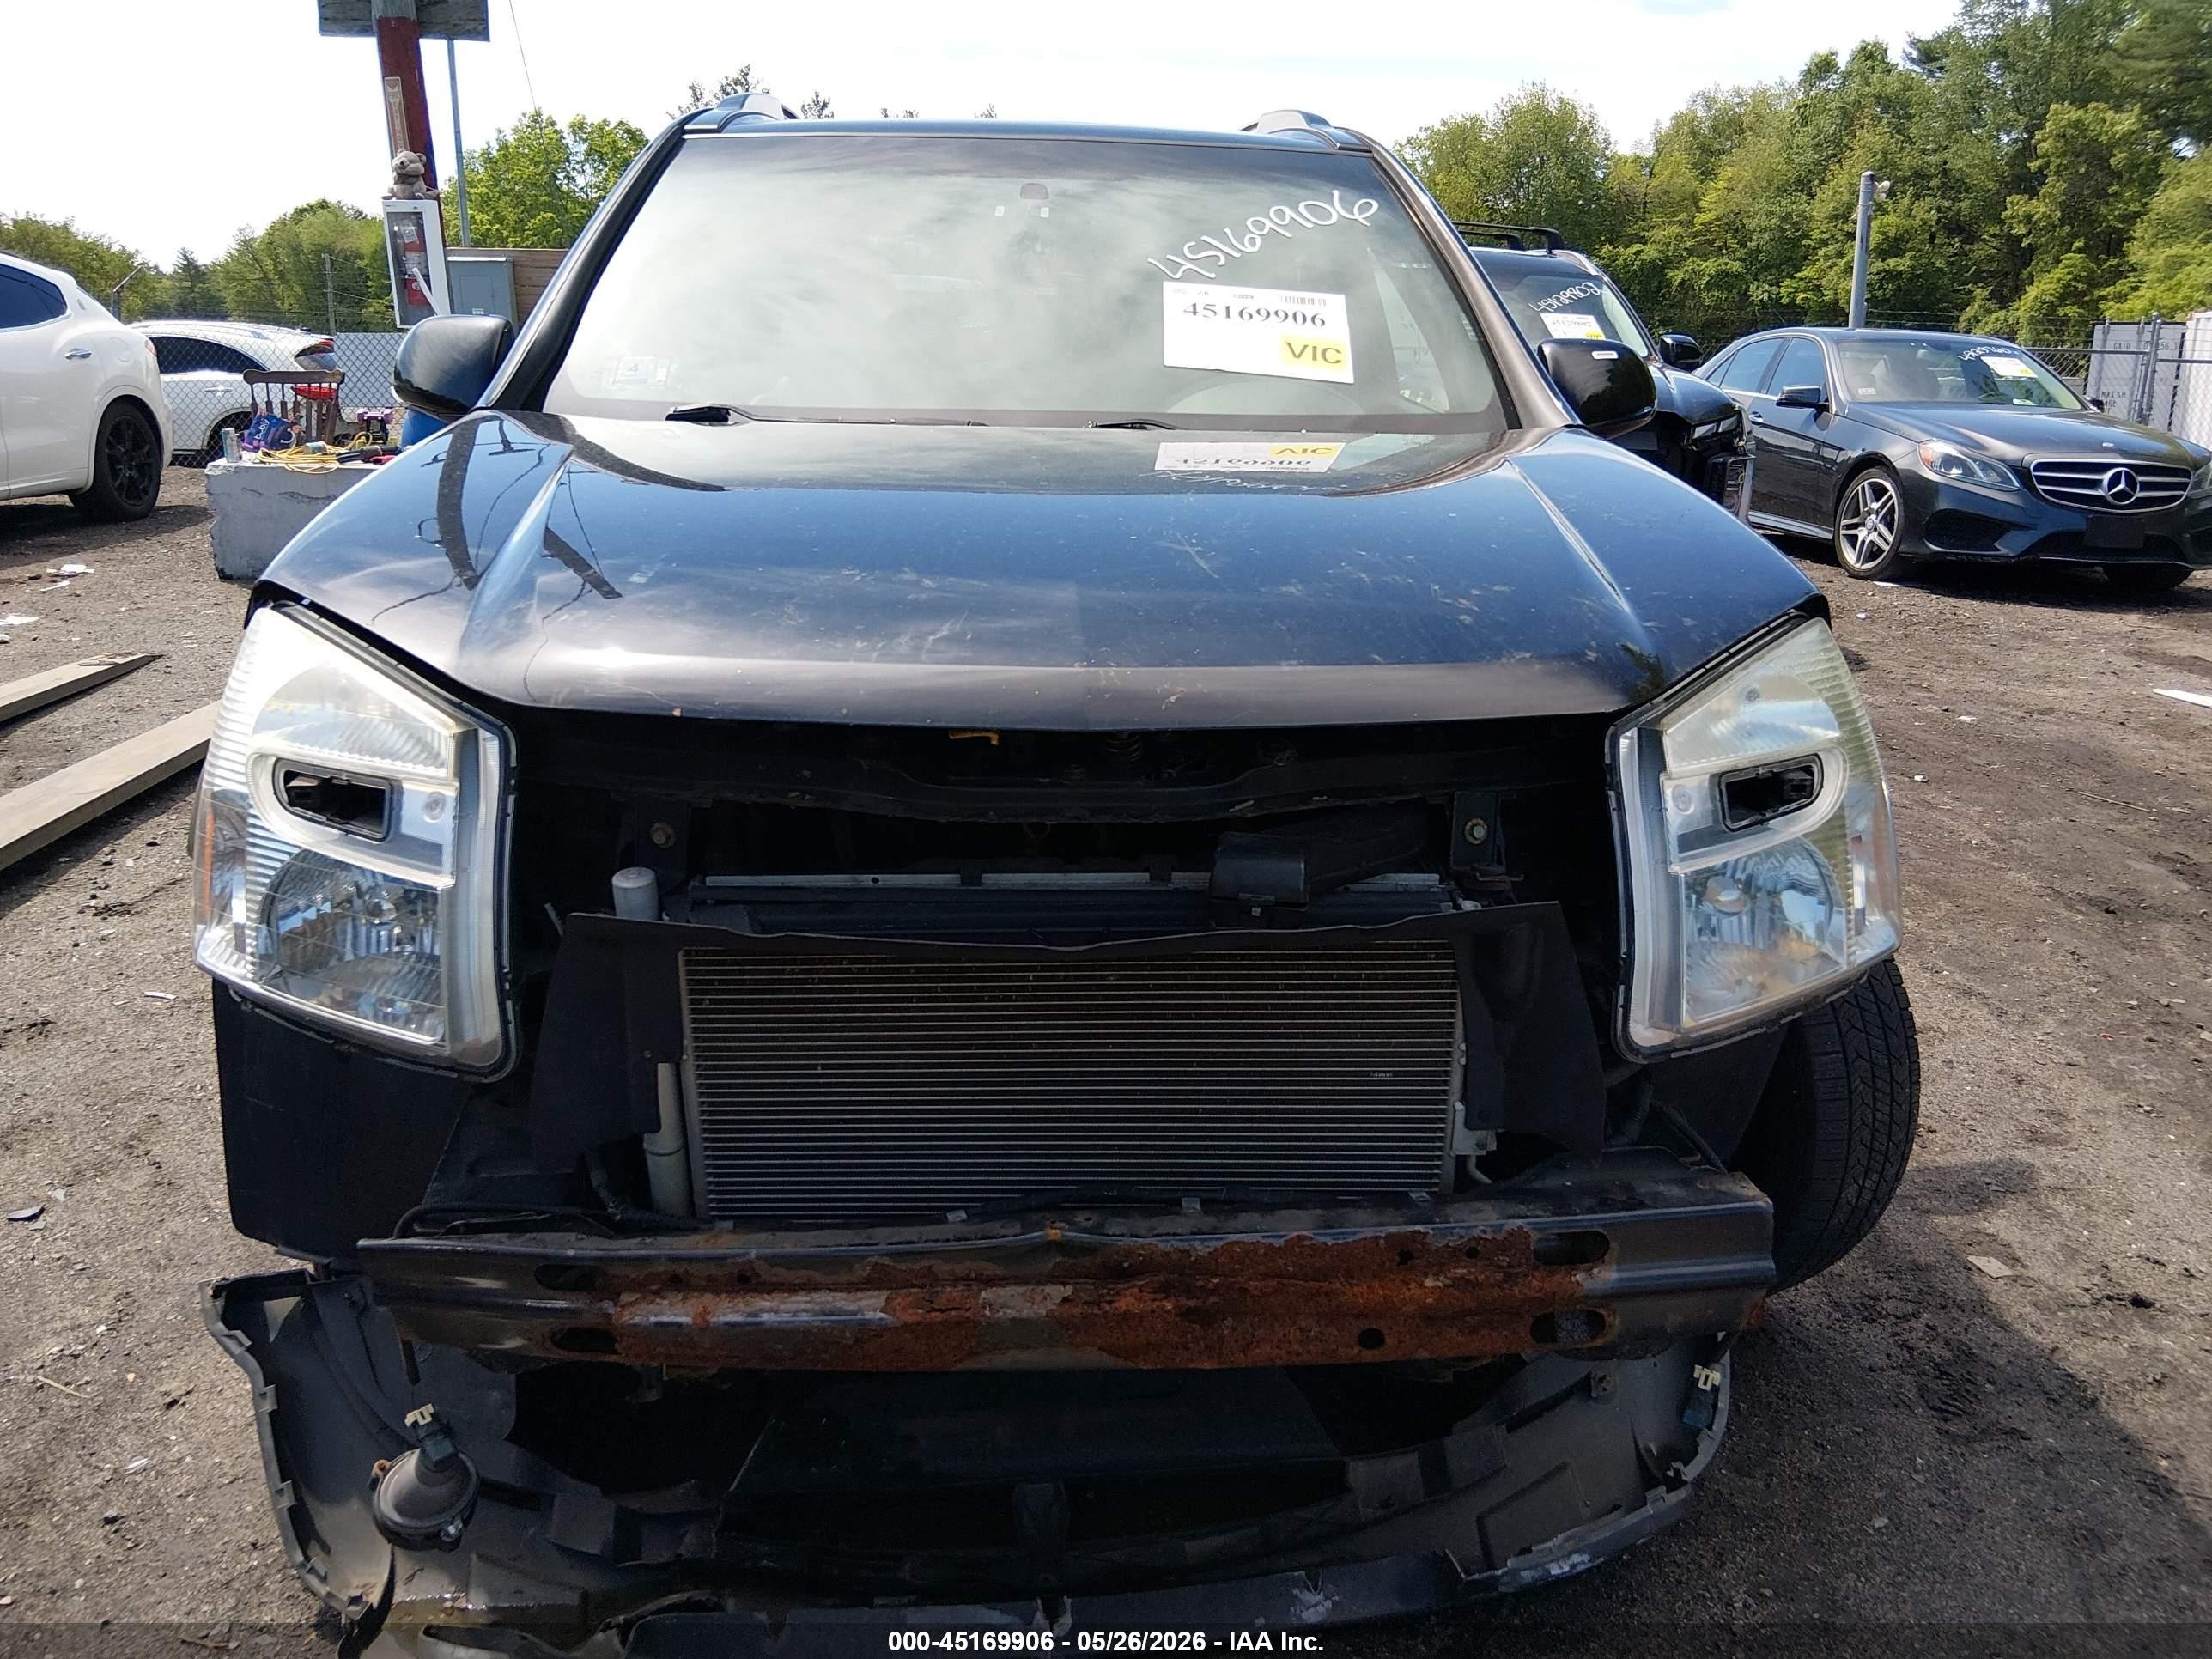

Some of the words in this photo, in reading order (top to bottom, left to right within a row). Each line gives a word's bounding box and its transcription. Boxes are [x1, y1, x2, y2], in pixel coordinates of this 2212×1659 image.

[1147, 189, 1379, 279] 45169906
[1182, 301, 1327, 328] 45169906
[1285, 342, 1342, 364] VIC
